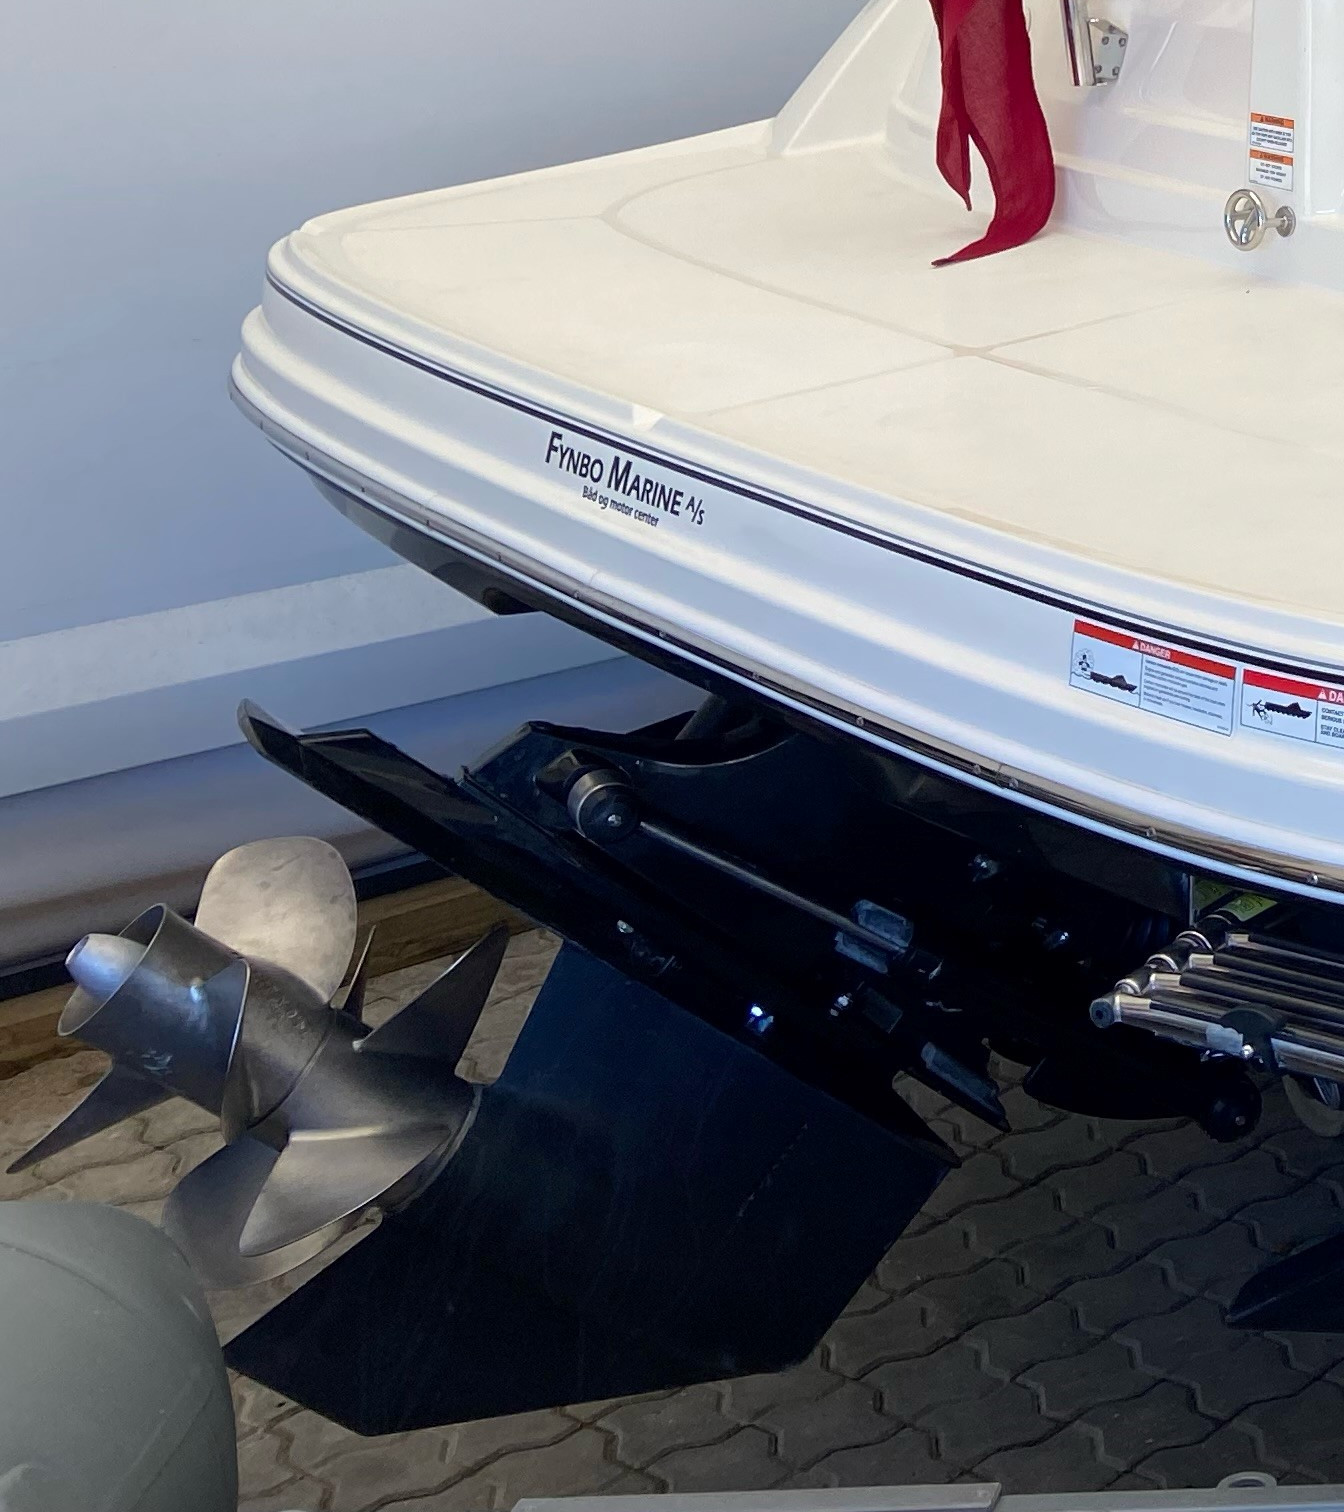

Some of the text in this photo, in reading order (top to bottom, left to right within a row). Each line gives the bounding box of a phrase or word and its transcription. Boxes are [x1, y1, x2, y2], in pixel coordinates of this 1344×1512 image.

[545, 430, 604, 483] FYNBO
[606, 455, 684, 517] MARINE
[609, 499, 633, 518] motor
[1139, 642, 1172, 660] DANGER
